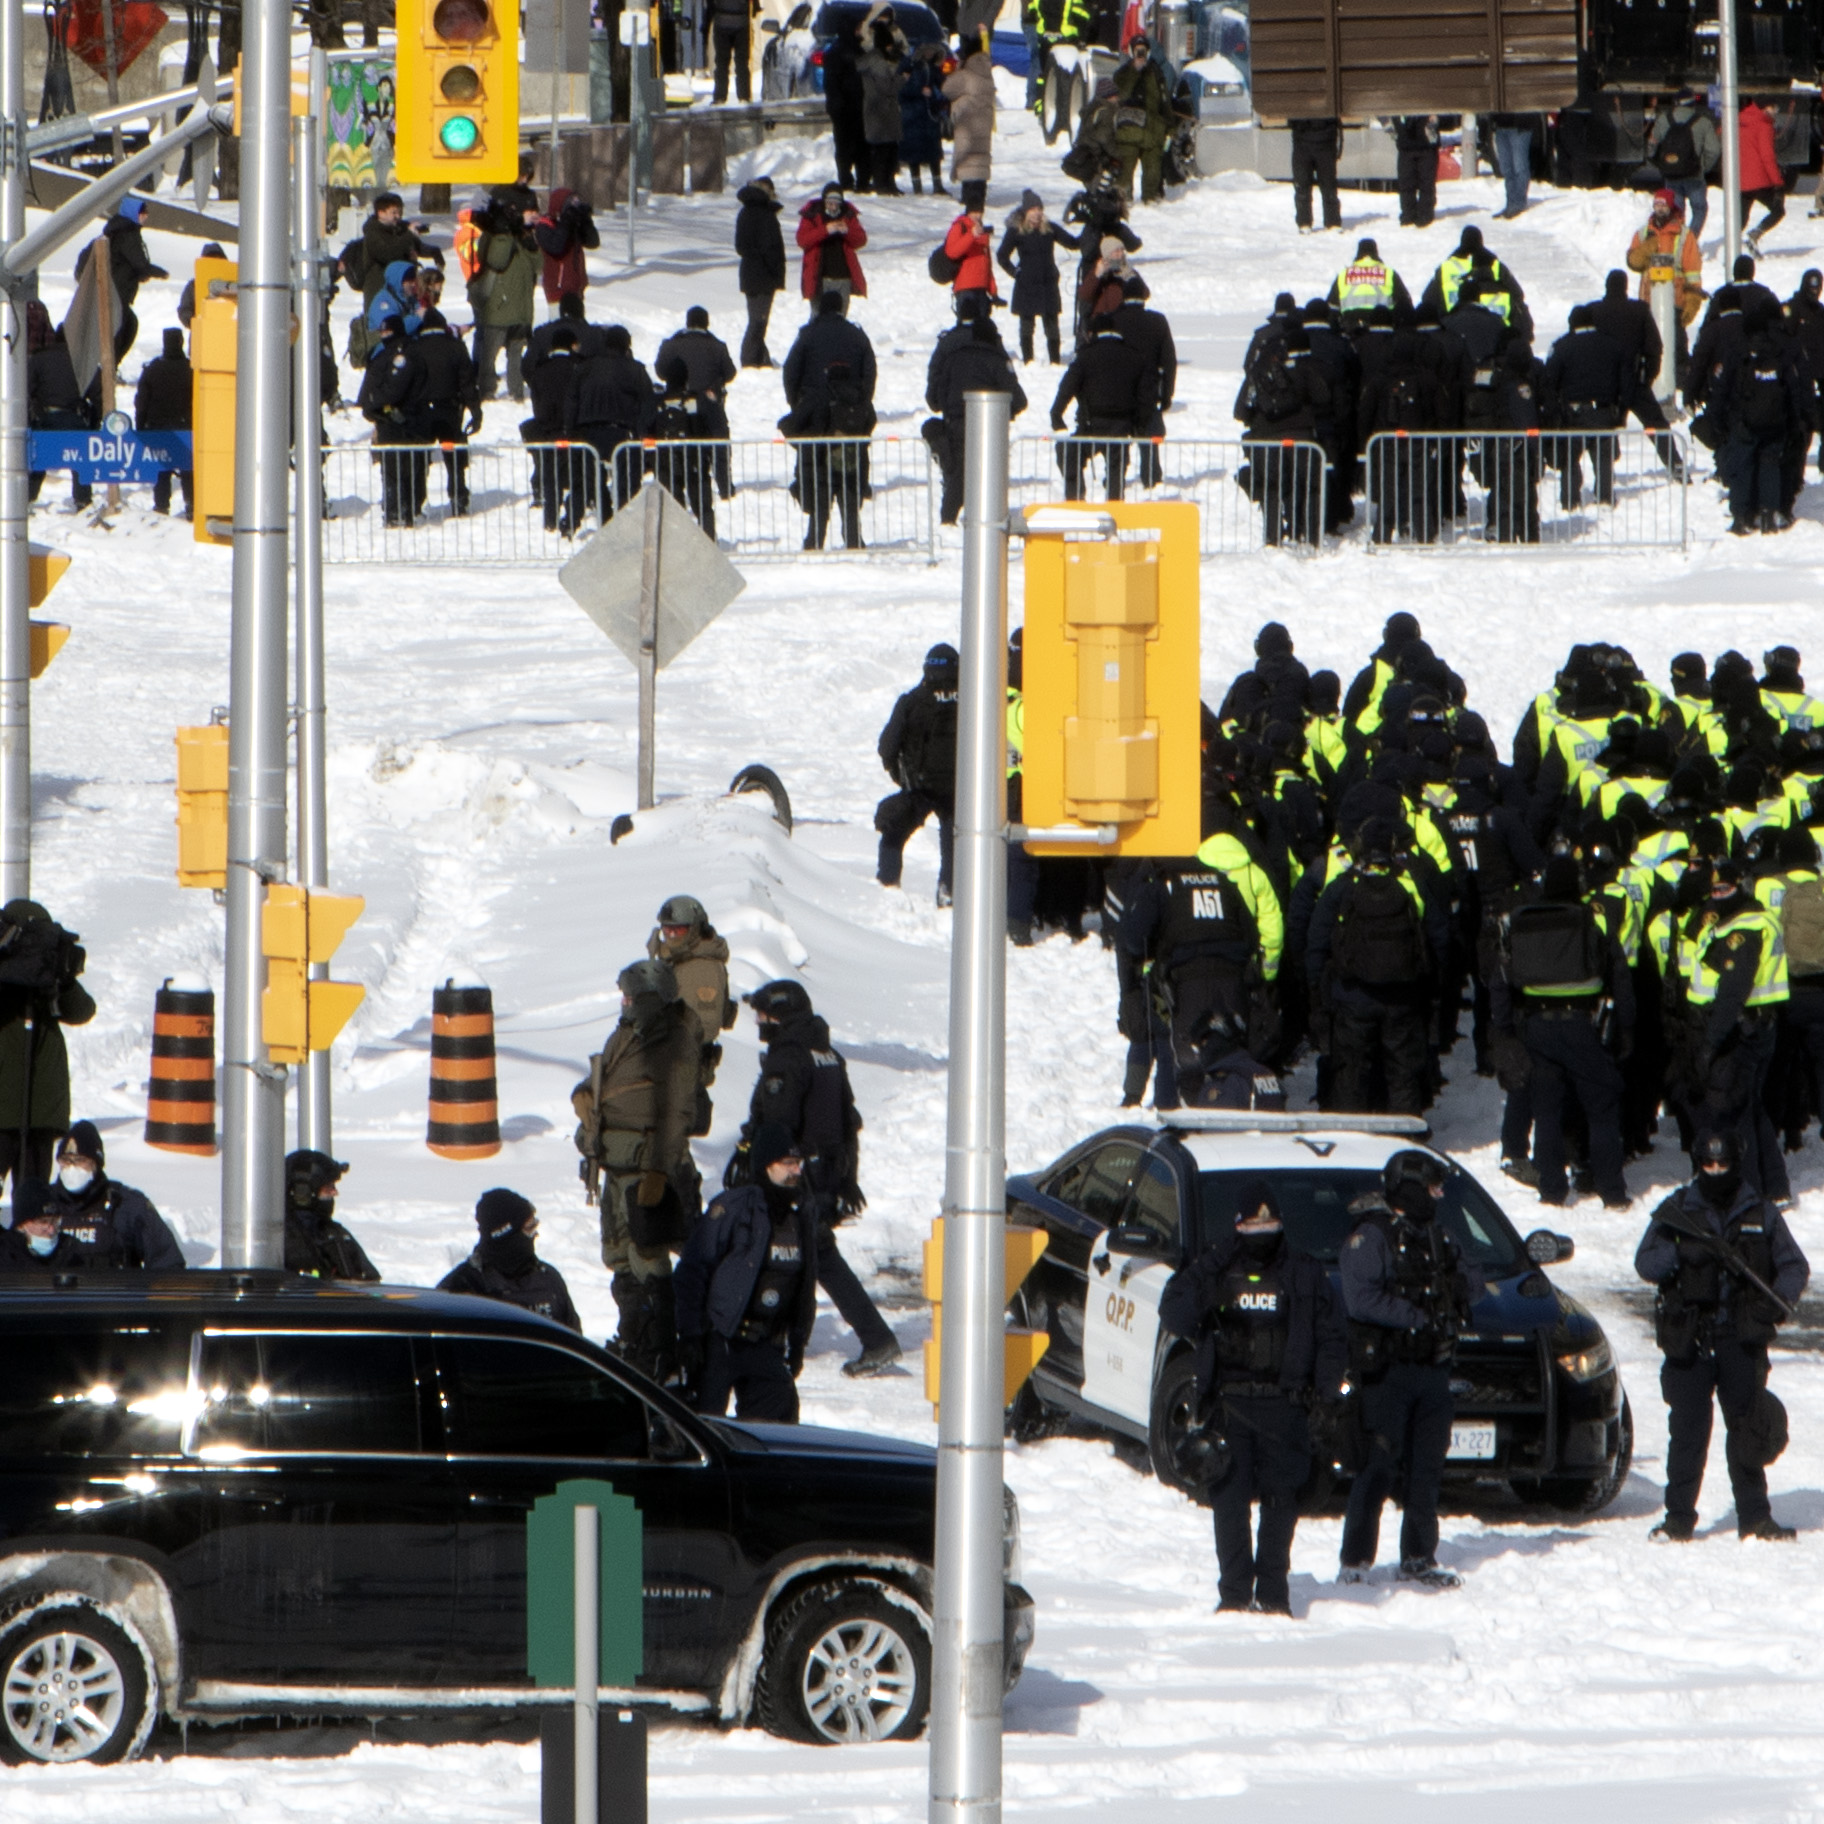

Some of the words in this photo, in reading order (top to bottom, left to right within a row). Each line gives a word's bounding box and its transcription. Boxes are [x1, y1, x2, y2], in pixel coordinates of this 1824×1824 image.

[62, 449, 83, 462] av.
[88, 434, 136, 468] Daly
[141, 447, 173, 463] Ave.
[1180, 874, 1219, 887] POLICE
[1192, 889, 1225, 920] A51
